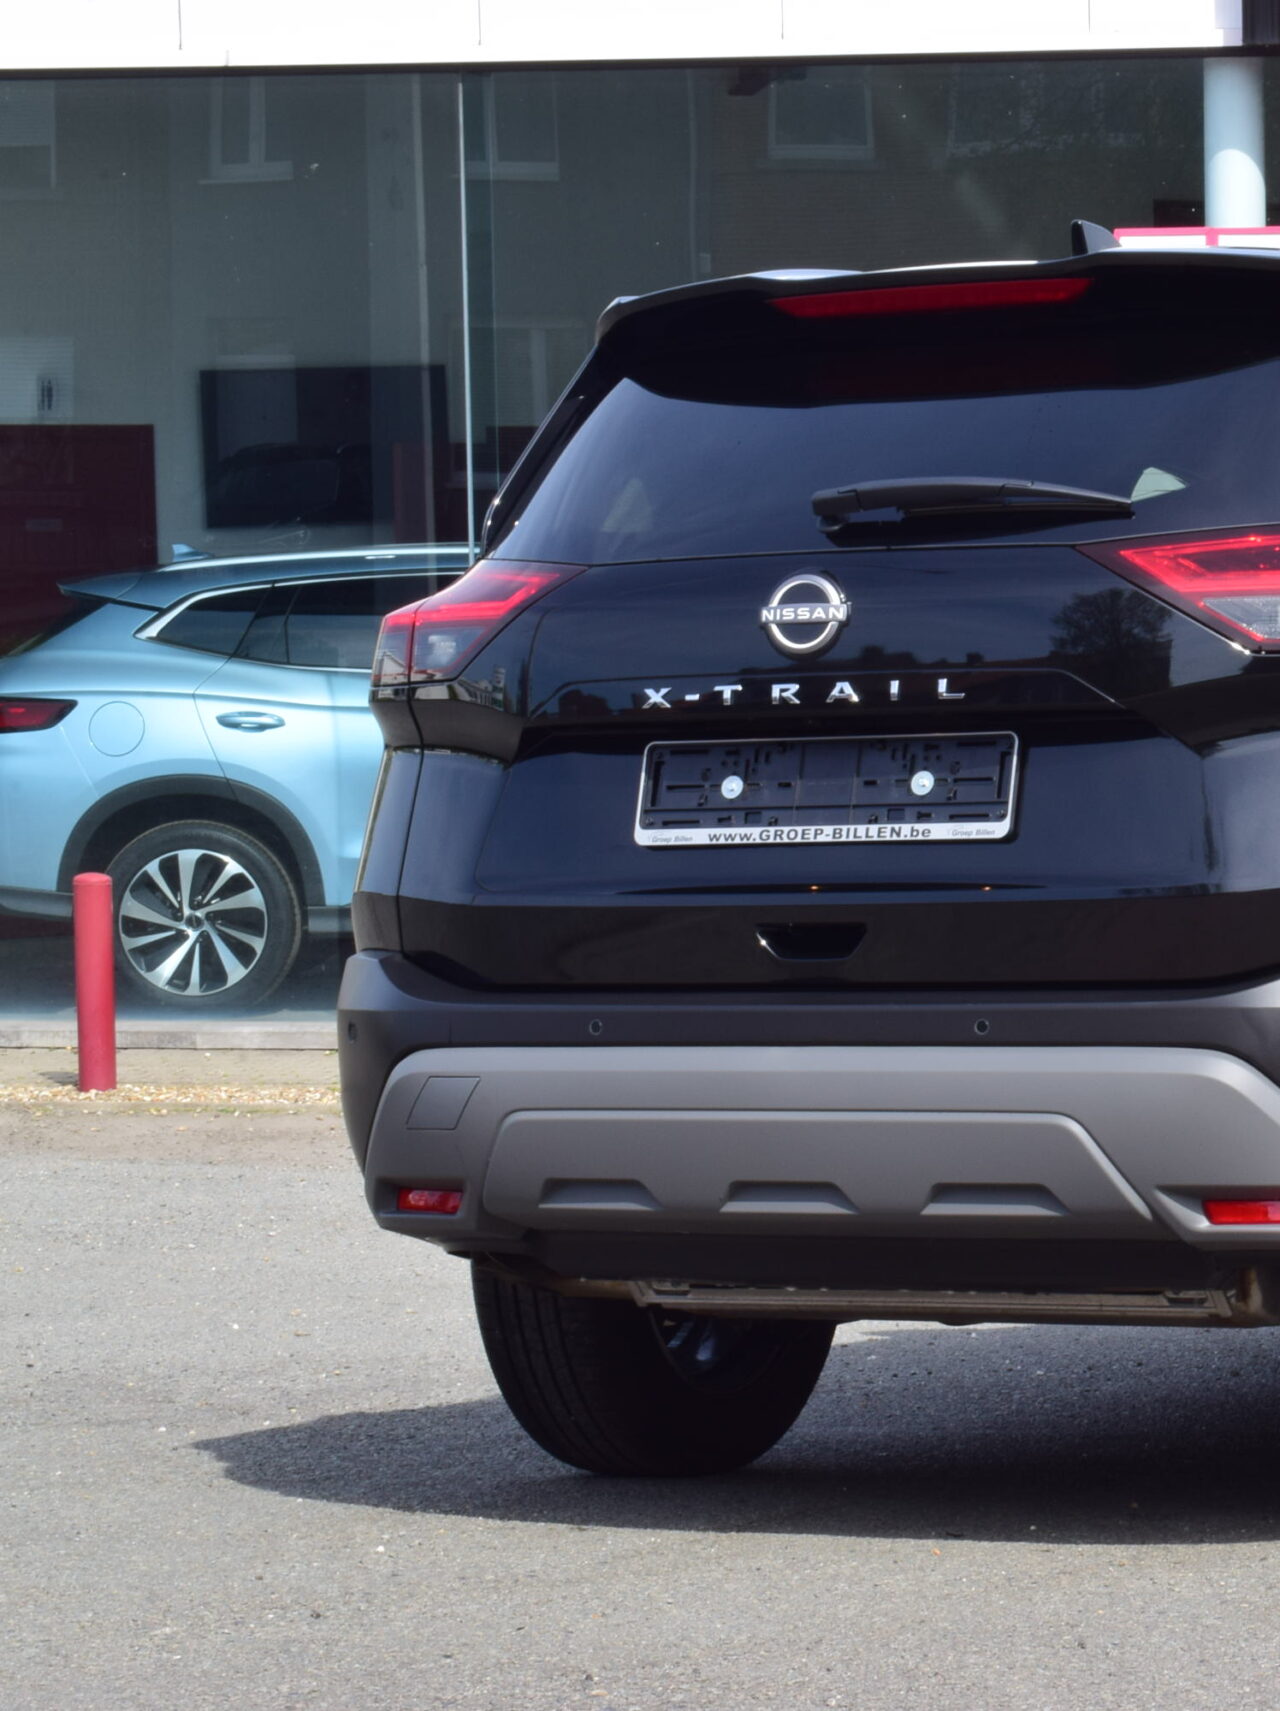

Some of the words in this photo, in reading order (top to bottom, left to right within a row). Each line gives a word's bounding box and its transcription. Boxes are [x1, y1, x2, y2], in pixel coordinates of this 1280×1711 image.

[761, 606, 844, 622] NISSAN
[641, 677, 966, 710] X-TRAIL
[708, 826, 932, 842] www.GROEP-BILLEN.be
[951, 829, 973, 838] Groep
[975, 828, 996, 836] Billen
